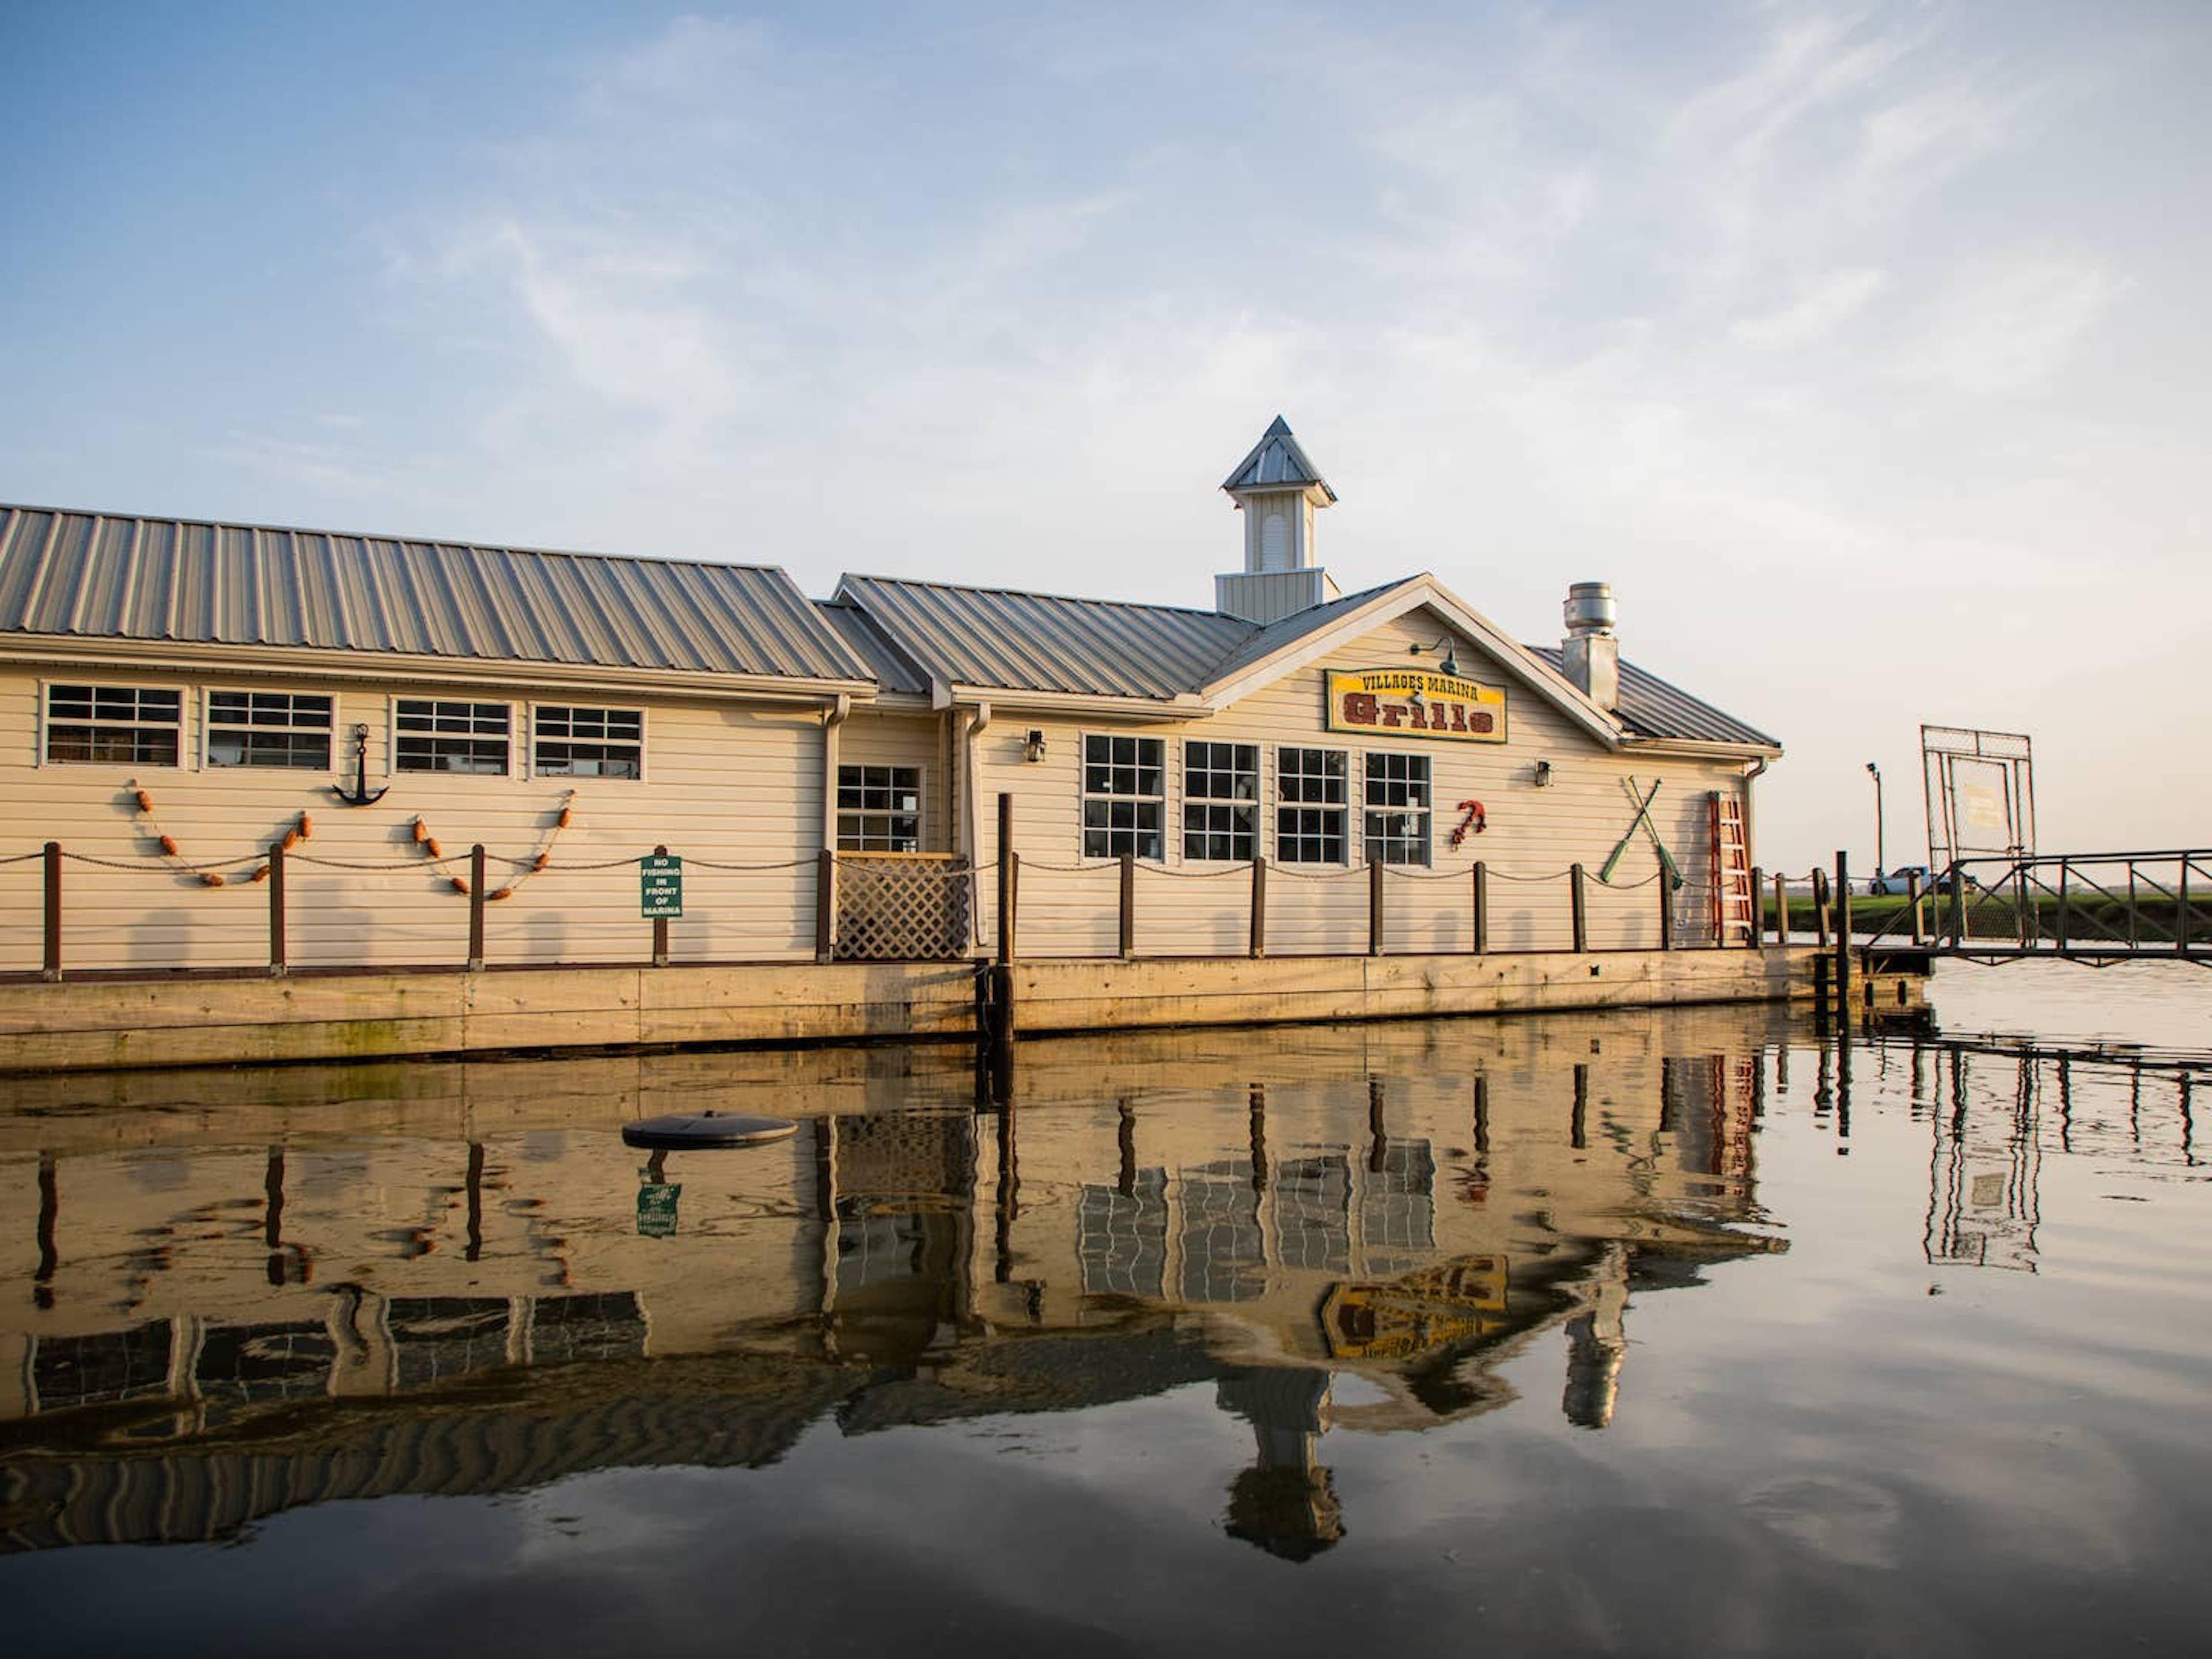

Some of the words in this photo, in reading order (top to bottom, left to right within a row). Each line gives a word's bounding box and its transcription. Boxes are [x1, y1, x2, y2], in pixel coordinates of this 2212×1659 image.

[1363, 675, 1423, 690] VILLAGES
[1428, 677, 1478, 700] MARINA
[654, 859, 669, 867] NO
[642, 868, 680, 876] FISHING
[656, 878, 667, 886] IN
[646, 887, 677, 896] FRONT
[655, 896, 668, 906] OF
[643, 907, 680, 915] MARINA
